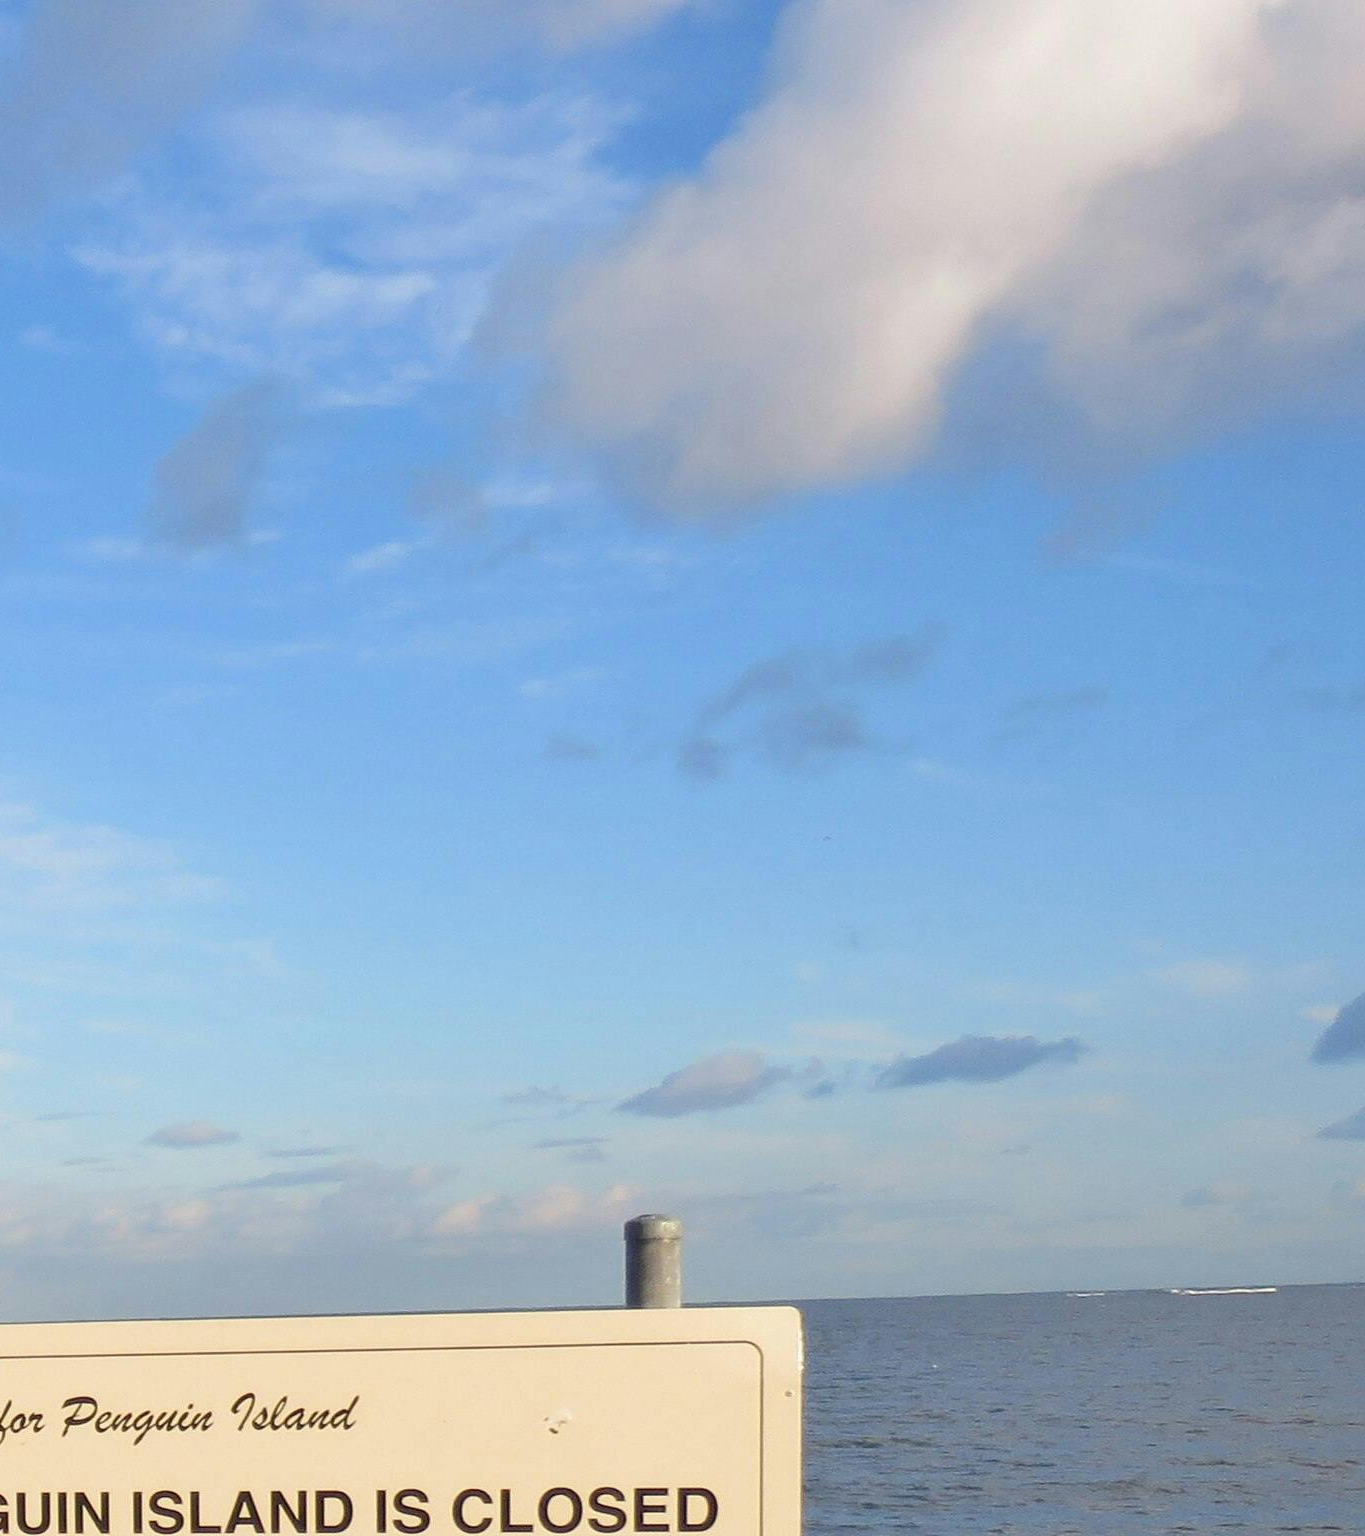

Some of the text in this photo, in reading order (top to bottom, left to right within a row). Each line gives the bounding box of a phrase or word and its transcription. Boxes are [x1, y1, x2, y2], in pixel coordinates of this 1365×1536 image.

[60, 1395, 213, 1447] Penguin
[230, 1392, 360, 1432] Island
[132, 1489, 354, 1536] ISLAND
[375, 1488, 432, 1535] IS
[451, 1486, 719, 1535] CLOSED
